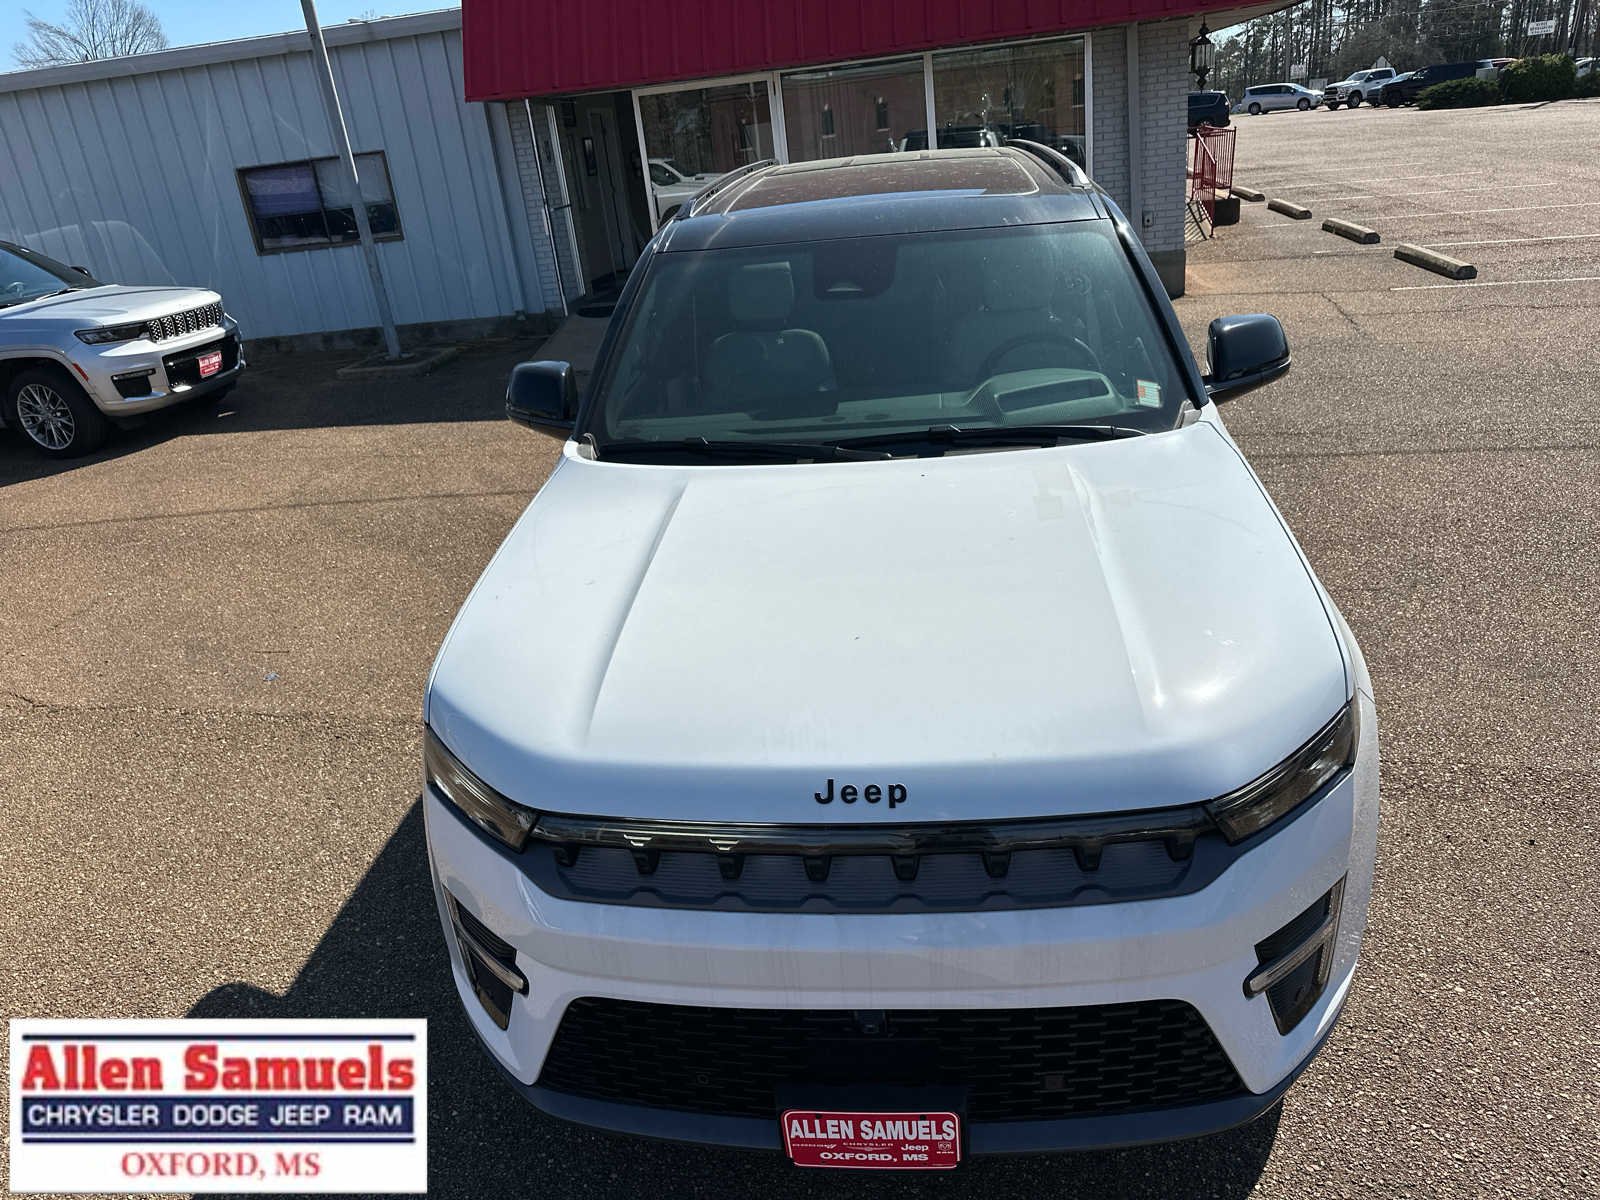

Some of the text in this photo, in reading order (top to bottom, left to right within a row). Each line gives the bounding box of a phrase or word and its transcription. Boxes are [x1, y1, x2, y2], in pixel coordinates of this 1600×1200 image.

[814, 778, 907, 809] Jeep
[790, 1119, 956, 1141] ALLEN SAMUELS
[900, 1143, 929, 1152] Jeep
[819, 1152, 929, 1162] OXFORD, MS
